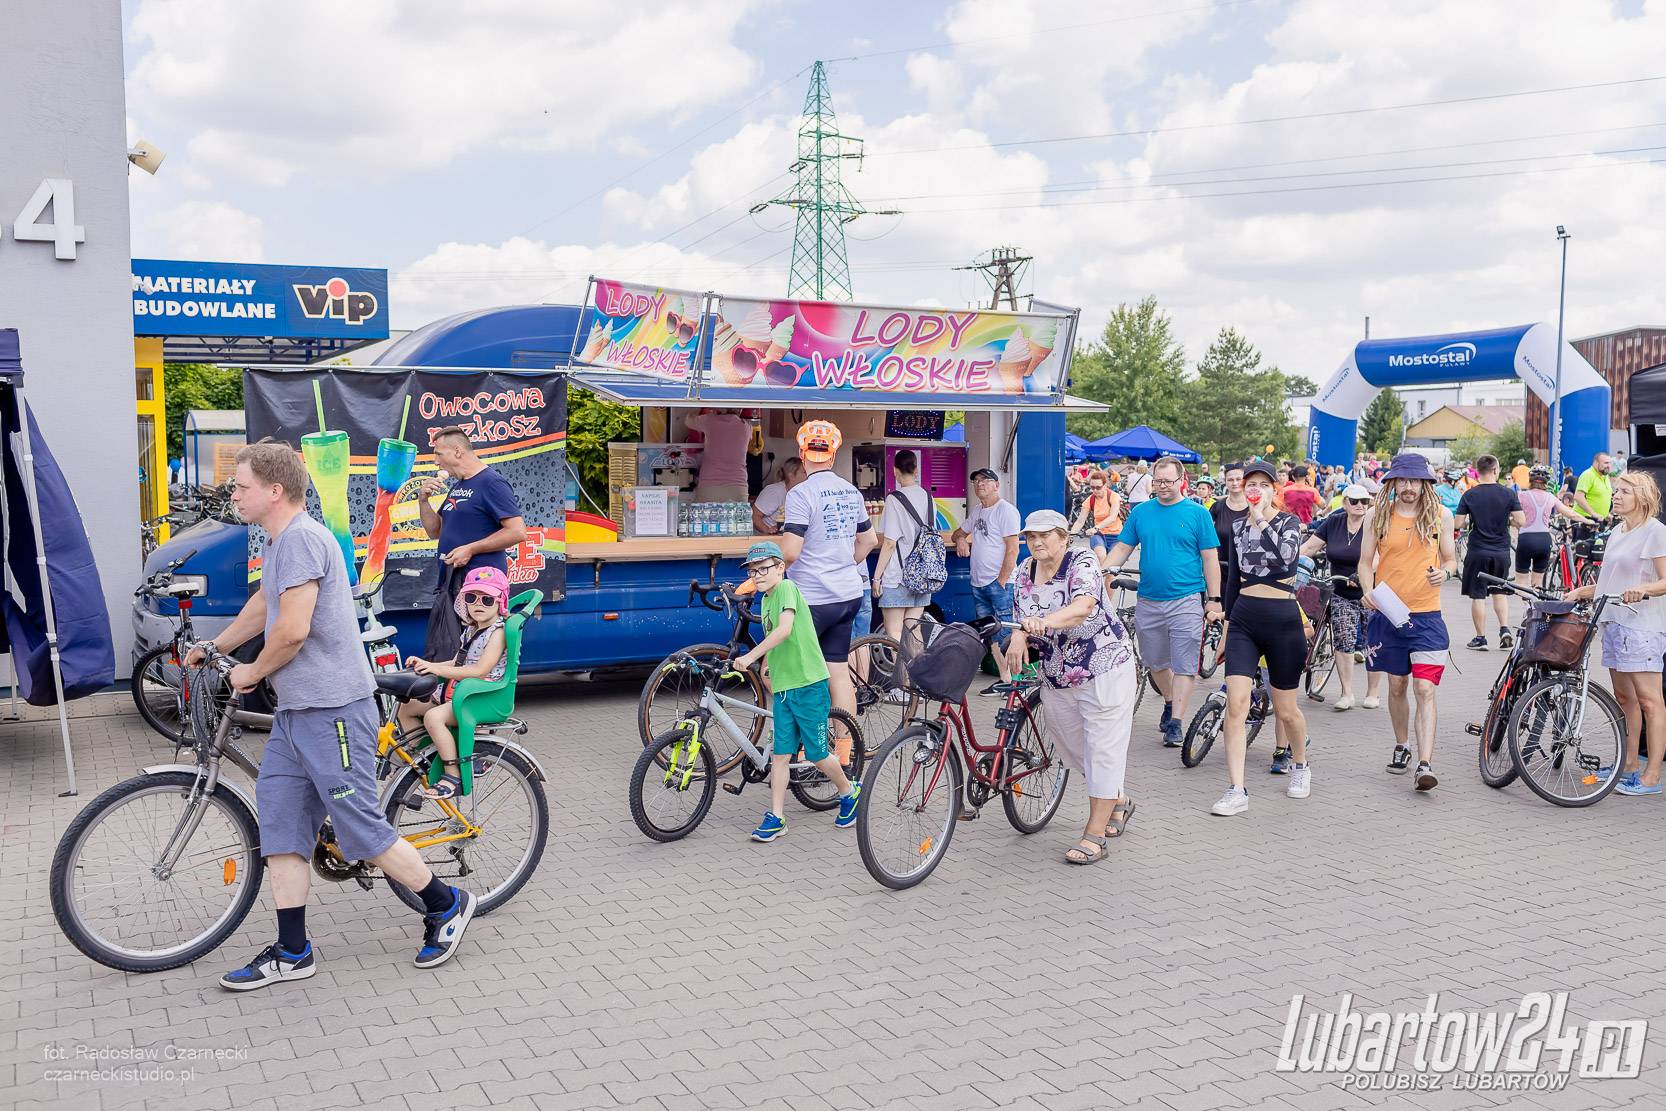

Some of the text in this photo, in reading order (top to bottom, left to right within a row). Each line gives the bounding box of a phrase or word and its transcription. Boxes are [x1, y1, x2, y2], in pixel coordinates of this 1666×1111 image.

[133, 275, 257, 296] MATERIAŁY
[134, 299, 277, 319] BUDOWLANE
[606, 288, 666, 323] LODY
[850, 309, 979, 350] LODY
[606, 338, 691, 377] WŁOSKIE
[811, 350, 997, 393] WŁOSKIE
[1389, 349, 1471, 367] Mostostal
[1522, 355, 1553, 390] Mostostal
[891, 414, 940, 429] LODY
